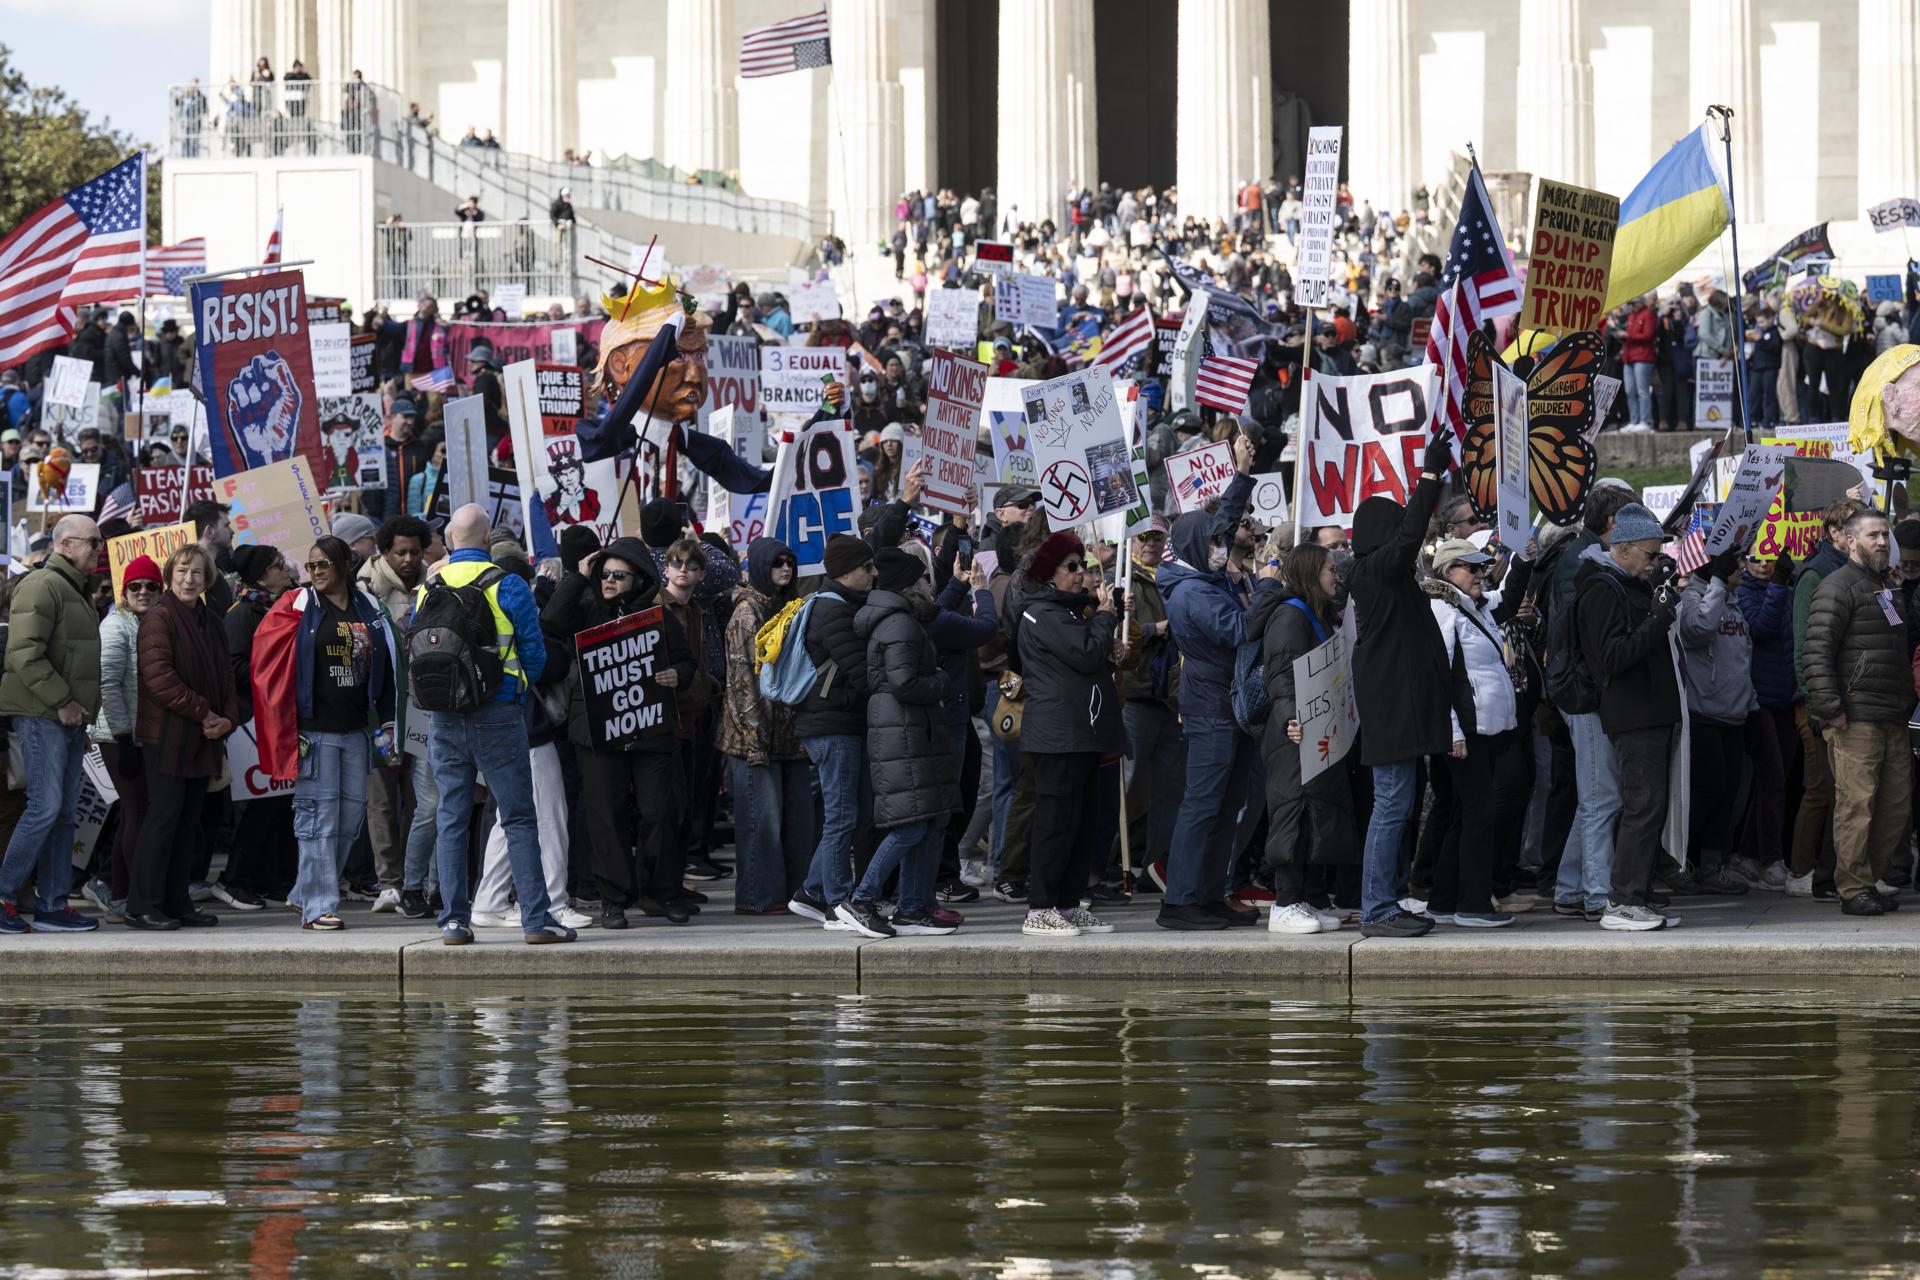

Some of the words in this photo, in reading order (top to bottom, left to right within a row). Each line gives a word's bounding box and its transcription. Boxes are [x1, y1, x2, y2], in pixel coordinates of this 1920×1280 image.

[1311, 176, 1334, 191] TYRANT
[1309, 194, 1332, 208] FASCIST
[1542, 184, 1578, 209] MAKE
[1580, 192, 1620, 221] AMERICA
[1308, 211, 1331, 225] RACIST
[1539, 207, 1580, 233] PROUD
[1582, 217, 1617, 244] AGAIN
[1535, 230, 1600, 264] DUMP
[1532, 258, 1605, 293] TRAITOR
[1872, 276, 1893, 289] ICE
[1302, 279, 1326, 305] TRUMP
[1875, 289, 1896, 301] OUT
[202, 283, 299, 347] RESIST!
[1531, 287, 1601, 331] TRUMP
[1157, 328, 1178, 341] TRU
[350, 342, 376, 357] UMP
[718, 339, 757, 371] WANT
[1158, 340, 1176, 352] MU
[350, 354, 373, 368] UST
[770, 351, 783, 372] 3
[788, 354, 843, 370] EQUAL
[1156, 363, 1173, 375] NO
[350, 376, 374, 389] OW!
[566, 371, 581, 386] SE
[930, 356, 951, 392] NO
[950, 363, 987, 403] KINGS
[1700, 371, 1731, 382] ELECT
[539, 386, 582, 400] LARGUE
[707, 376, 756, 414] YOU
[1091, 385, 1113, 418] NAZIS
[44, 405, 94, 425] KNGS
[352, 396, 383, 435] PIRATE
[540, 400, 581, 416] TRUMP
[937, 401, 972, 429] ANYTIME
[1314, 378, 1427, 441] NO
[1474, 400, 1494, 416] PROT
[1530, 401, 1572, 416] CHILDREN
[551, 418, 572, 432] YA!
[1080, 410, 1095, 432] NO
[1776, 426, 1818, 435] CONGRESS
[1827, 424, 1850, 432] COMP
[923, 426, 960, 458] VIOLATORS
[960, 438, 975, 463] WILL
[1009, 454, 1034, 473] PEDO
[1188, 453, 1216, 473] NO
[1201, 462, 1234, 484] KING
[1722, 457, 1738, 476] NO
[140, 468, 187, 490] TEAR
[193, 467, 215, 484] TH
[938, 458, 974, 489] REMOVED!
[1198, 484, 1221, 499] ANY
[1506, 508, 1519, 532] IDIOT
[1738, 505, 1758, 519] Just
[595, 521, 619, 541] YOU
[774, 487, 854, 565] ICE
[116, 535, 147, 567] DUMP
[150, 528, 188, 559] TRUMP
[1758, 523, 1782, 557] &
[326, 645, 352, 656] ILLEGAL
[583, 629, 661, 673] TRUMP
[329, 665, 353, 678] STOLEN
[337, 676, 354, 687] LAND
[594, 654, 655, 695] MUST
[612, 684, 645, 712] GO
[605, 701, 663, 742] NOW!
